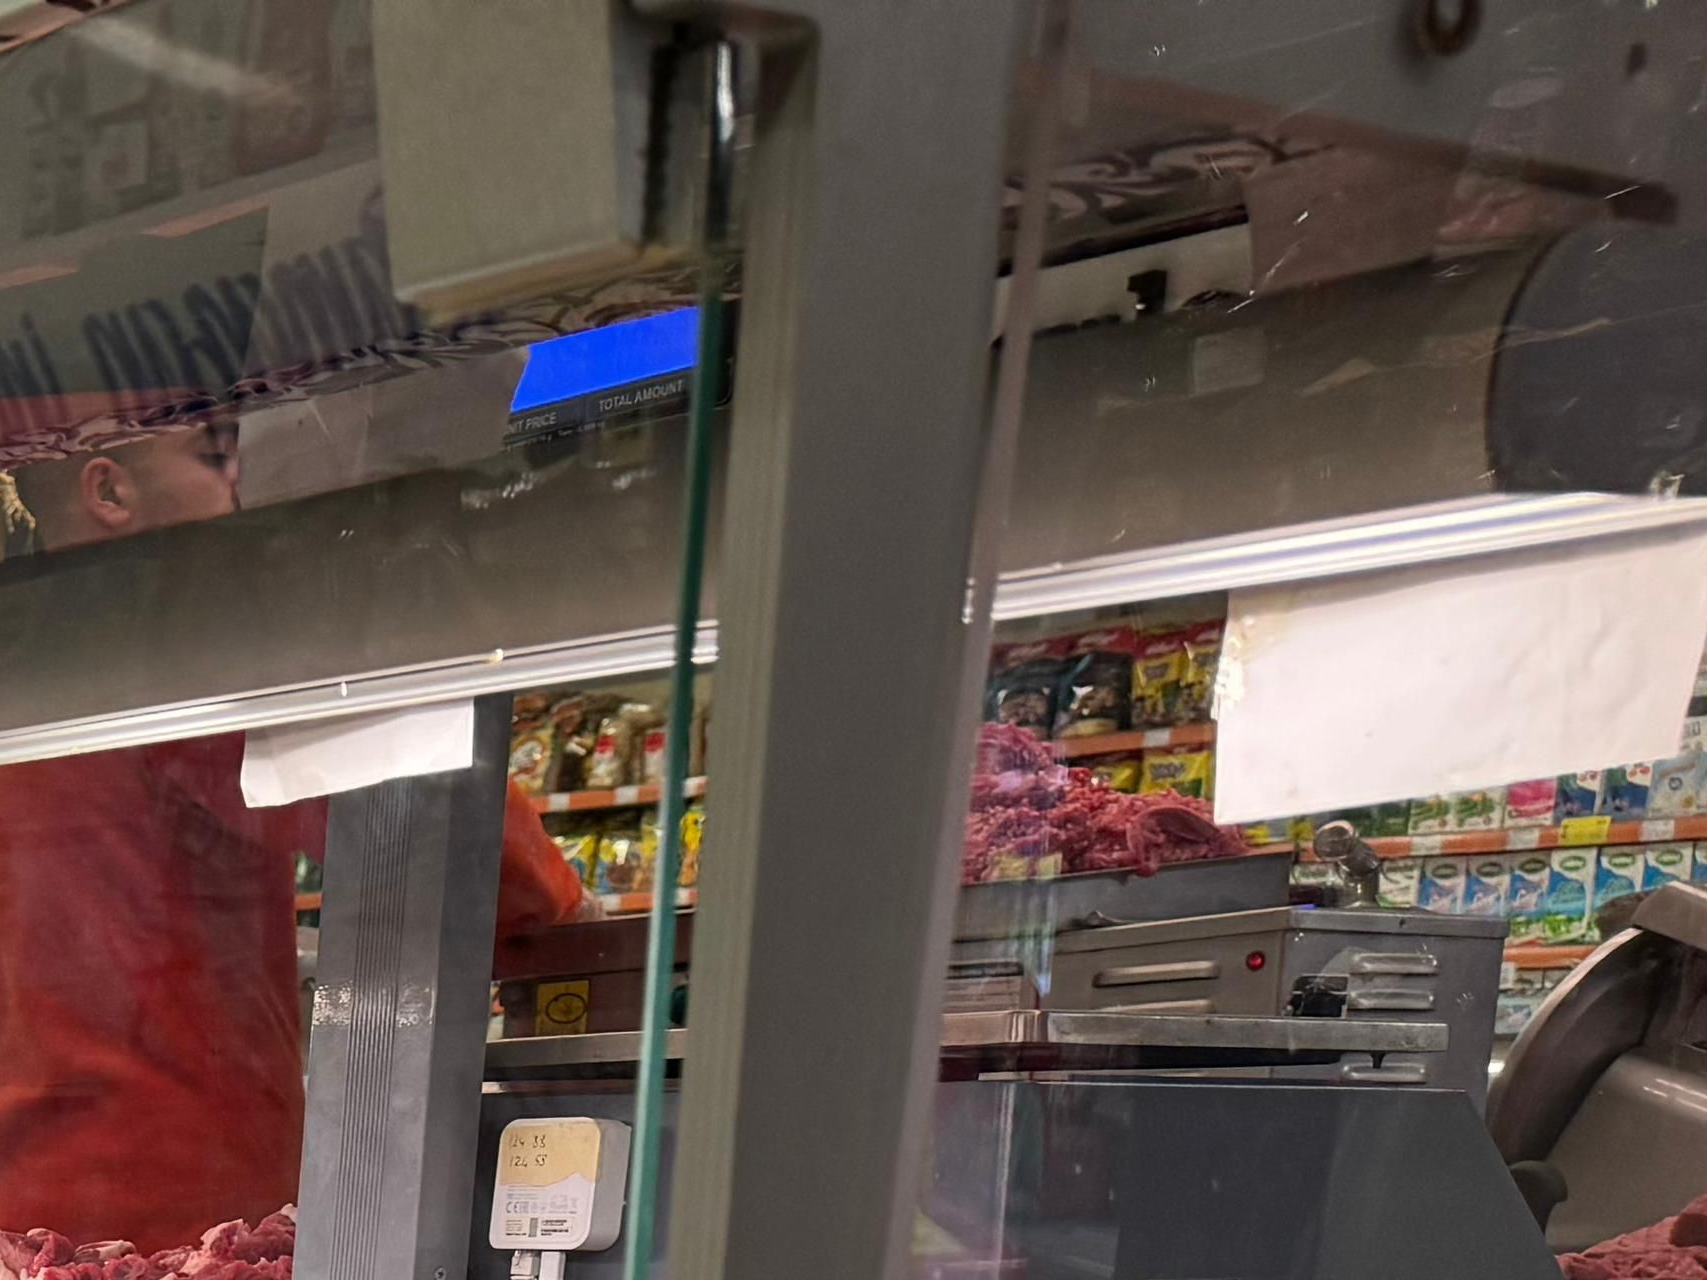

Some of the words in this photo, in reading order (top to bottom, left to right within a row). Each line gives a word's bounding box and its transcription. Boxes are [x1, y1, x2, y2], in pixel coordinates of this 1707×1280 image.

[598, 396, 632, 413] TOTAL
[635, 379, 684, 404] AMOUNT
[525, 412, 557, 431] PRICE
